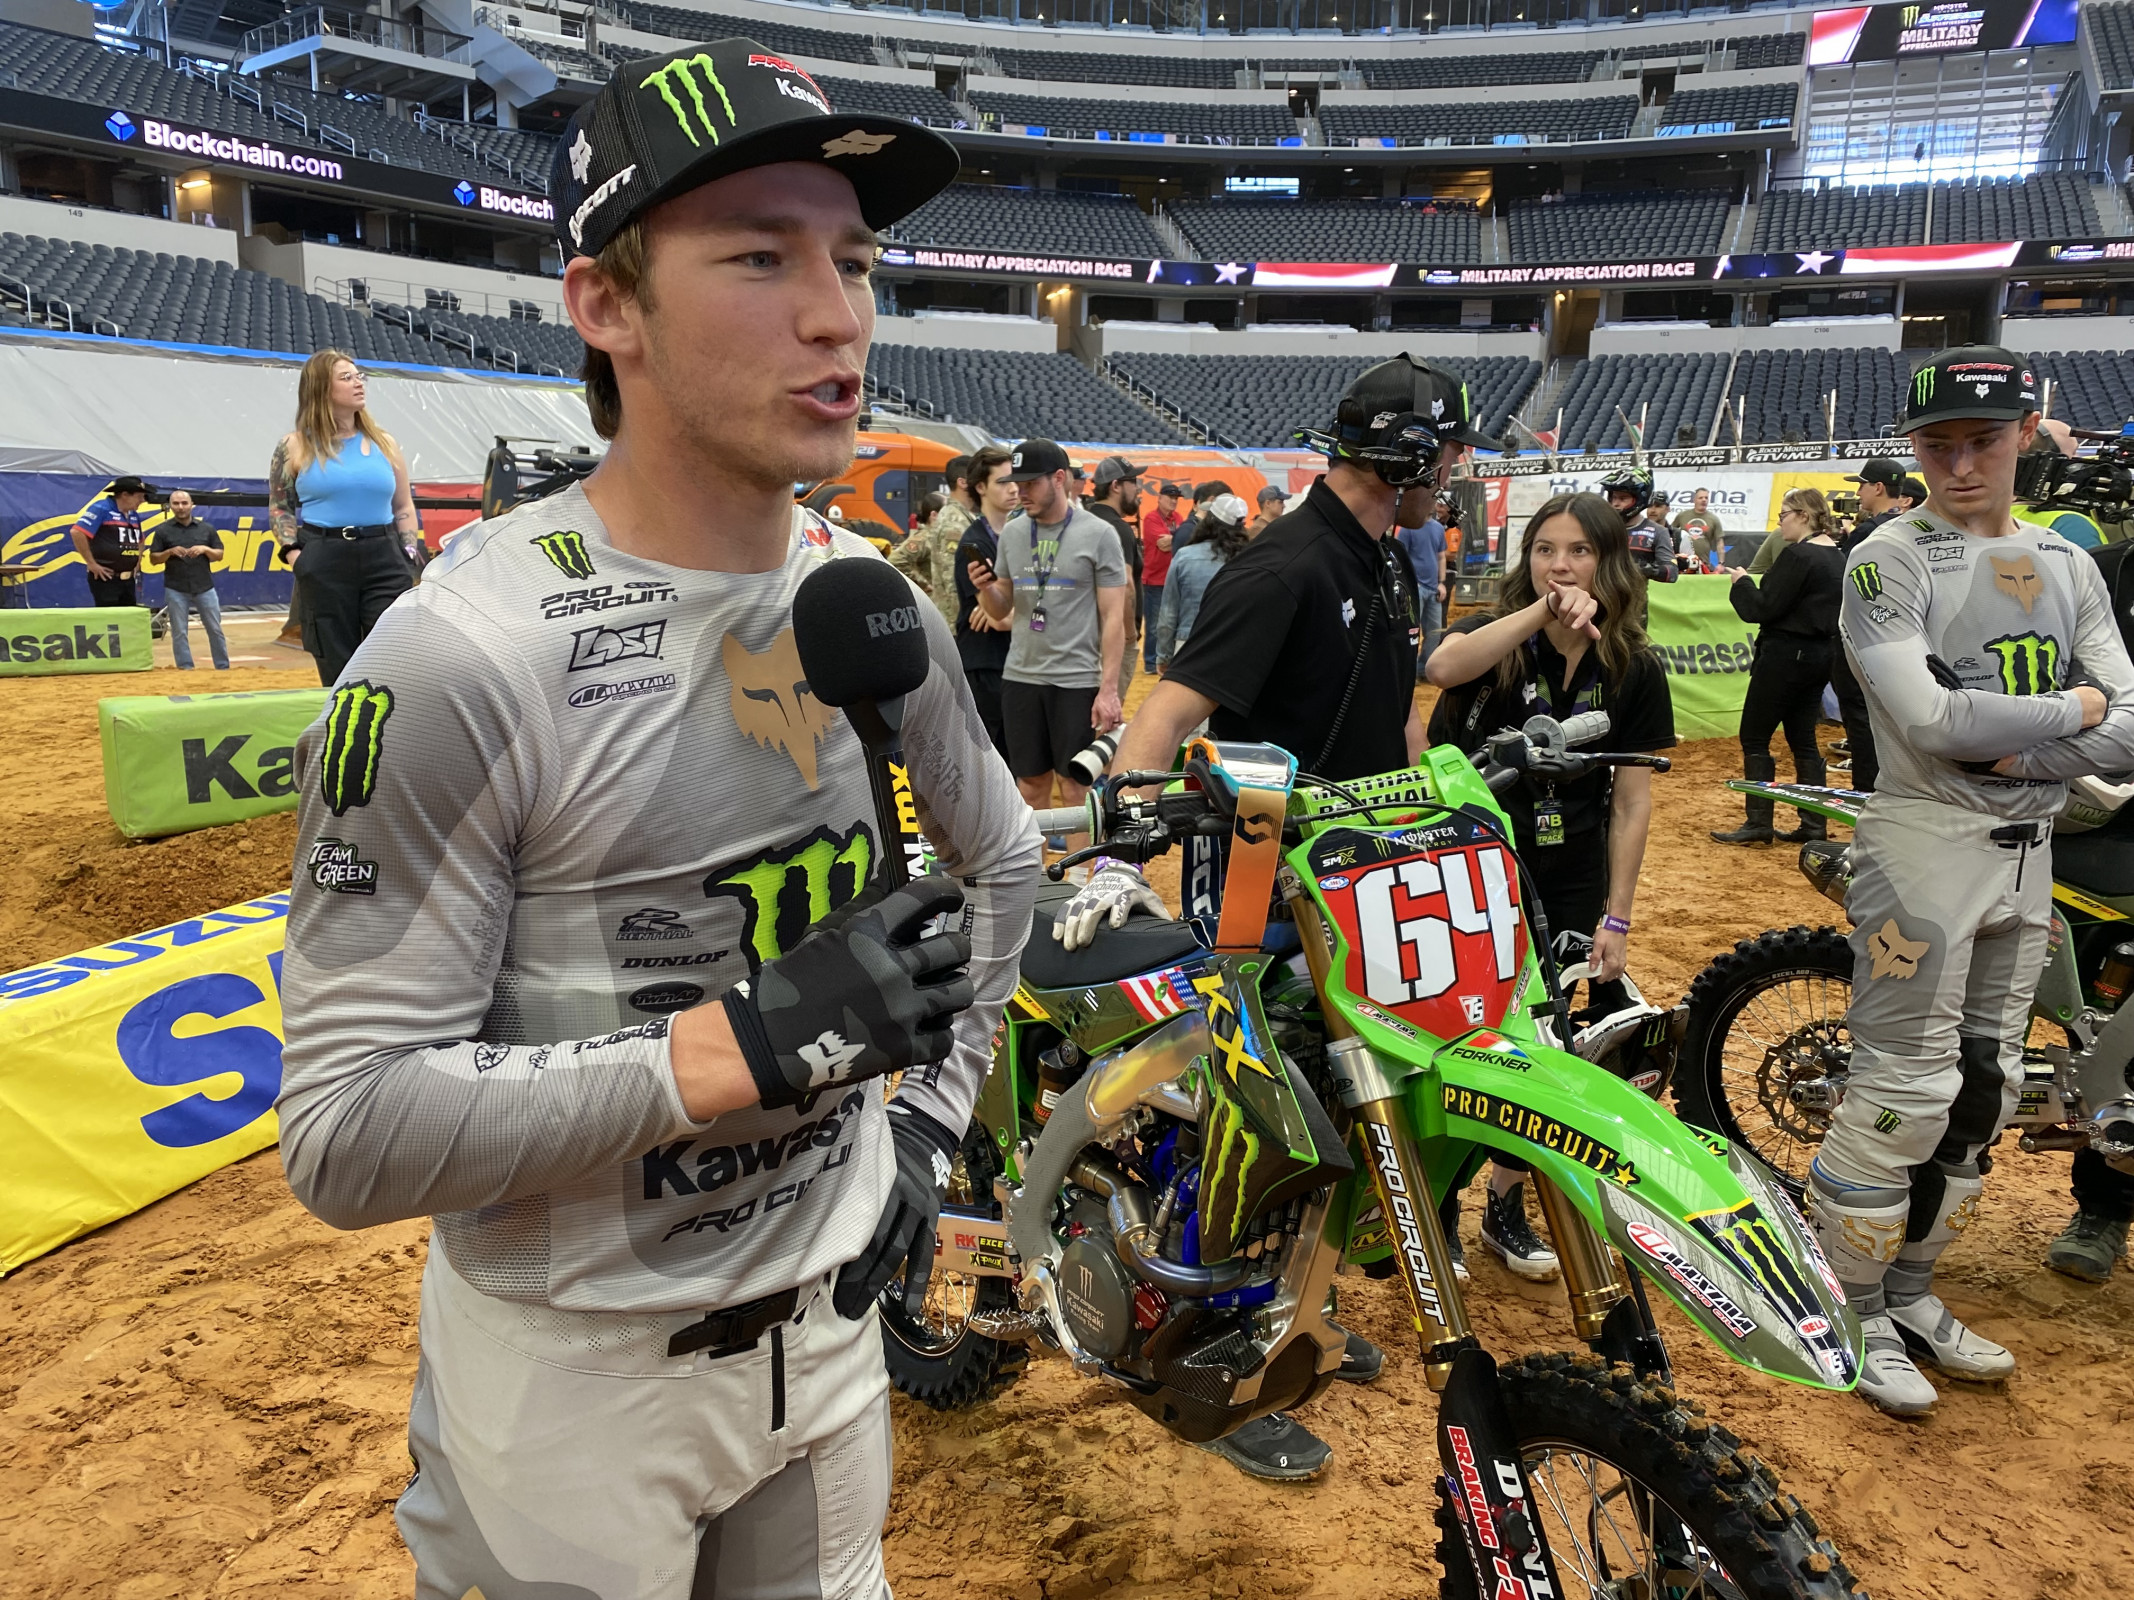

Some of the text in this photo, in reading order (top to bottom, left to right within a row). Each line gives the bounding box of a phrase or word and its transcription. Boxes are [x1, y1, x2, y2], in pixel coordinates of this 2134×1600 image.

[1900, 23, 1984, 43] MILITARY
[1899, 37, 1978, 51] APPRECIATION RACE
[143, 119, 343, 180] Blockchain.com
[68, 208, 83, 218] 149
[915, 250, 986, 269] MILITARY
[985, 254, 1093, 275] APPRECIATION
[1094, 262, 1132, 277] RACE
[1461, 268, 1532, 284] MILITARY
[1532, 265, 1650, 281] APPRECIATION
[1651, 262, 1695, 277] RACE
[1956, 373, 2007, 383] Kawasaki
[1688, 449, 1725, 457] MOUNTAIN
[1784, 445, 1823, 453] MOUNTAIN
[1509, 459, 1544, 467] MOUNTAIN
[1915, 533, 1943, 542] PRO
[540, 585, 613, 610] PRO
[544, 588, 676, 620] CIRCUIT
[612, 684, 676, 701] RACING OILS
[1981, 779, 2026, 789] PRO
[1550, 814, 1562, 827] B
[1394, 826, 1458, 846] MONSTER
[1537, 833, 1563, 843] TRACK
[308, 841, 353, 865] TEAM
[1322, 850, 1357, 868] SMX
[315, 862, 373, 888] GREEN
[615, 929, 694, 941] RENTHAL
[1354, 847, 1520, 1007] 64
[620, 950, 729, 969] DUNLOP
[636, 989, 699, 1006] Twin Air
[1191, 970, 1276, 1086] KX
[1451, 1047, 1532, 1073] FORKNER
[1632, 1074, 1656, 1088] BELL
[1443, 1086, 1618, 1174] PRO CIRCUIT
[661, 1198, 758, 1243] PRO
[1370, 1122, 1408, 1194] PRO
[1391, 1194, 1448, 1327] CIRCUIT
[955, 1233, 977, 1248] RK
[1657, 1243, 1758, 1334] MAXIMA
[1066, 1288, 1105, 1318] PRO CIRCUIT
[1664, 1263, 1745, 1339] RACING OILS
[1066, 1295, 1104, 1330] Kawasaki
[1070, 1308, 1100, 1333] Racing Team
[1800, 1317, 1826, 1334] BELL
[1447, 1425, 1500, 1549] BRAKING
